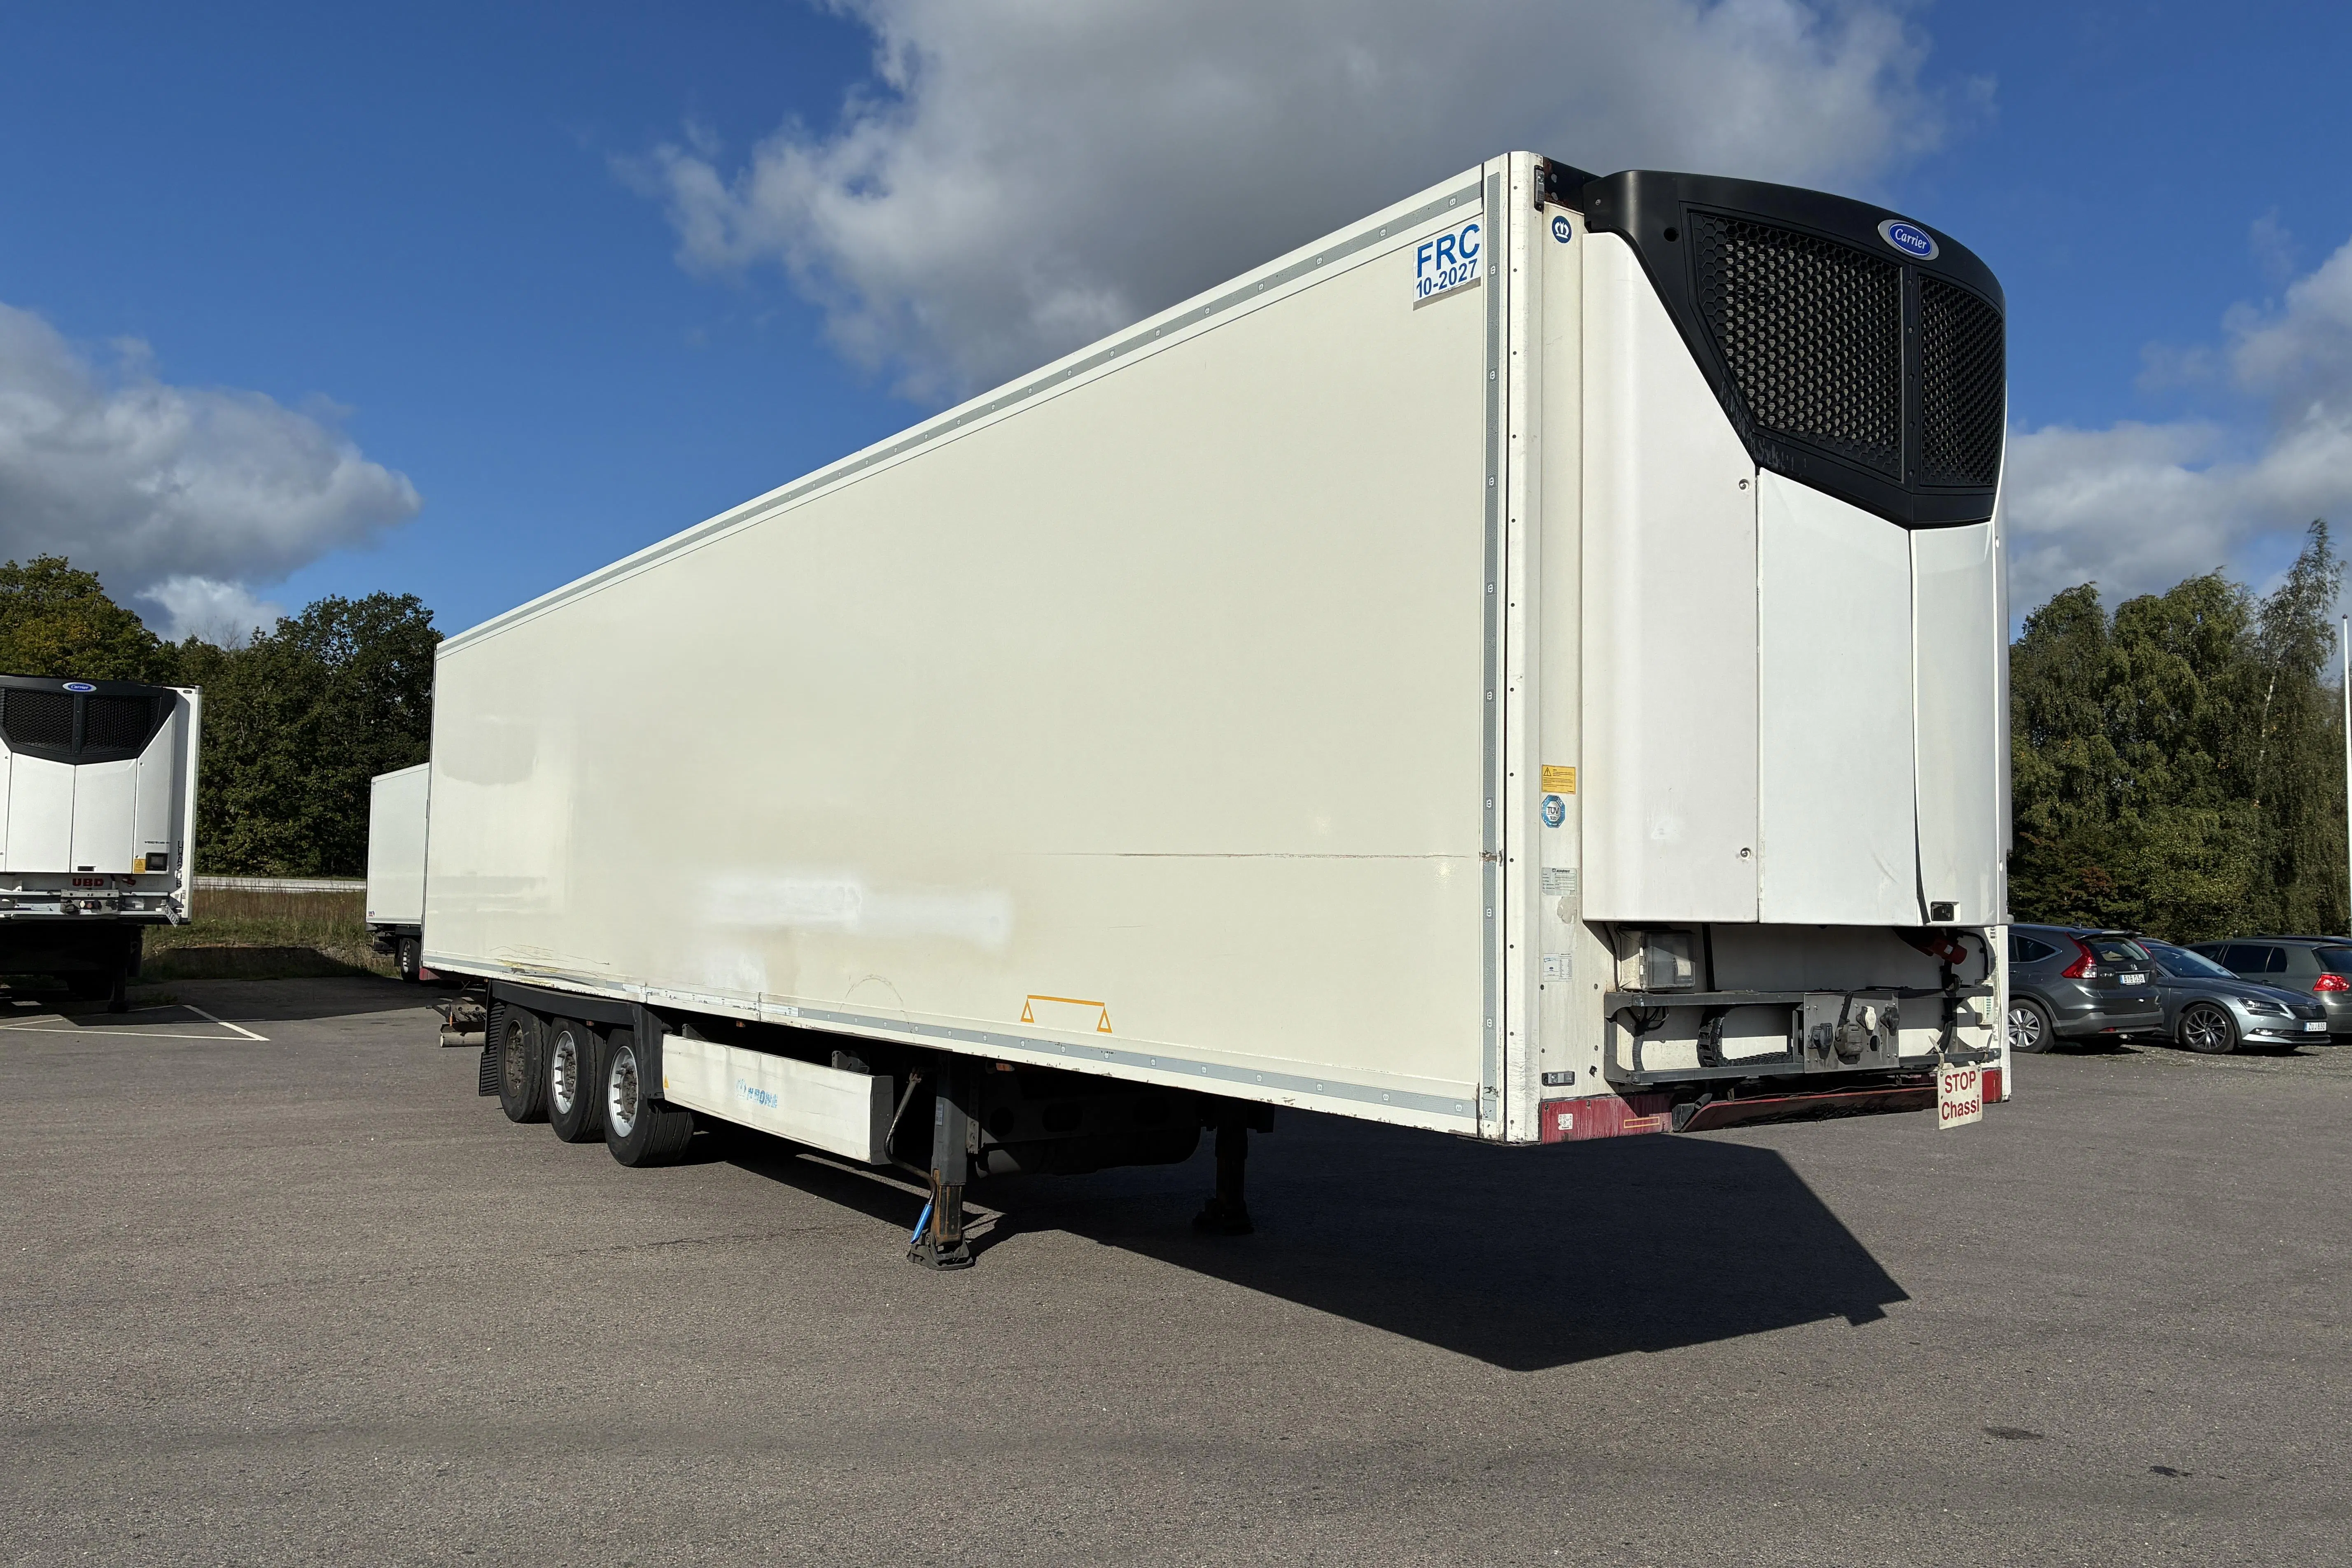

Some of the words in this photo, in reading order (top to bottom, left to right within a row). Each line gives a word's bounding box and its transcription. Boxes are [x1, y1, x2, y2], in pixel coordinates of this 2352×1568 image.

[1417, 224, 1480, 278] FRC
[1895, 229, 1927, 249] Carrier
[1416, 258, 1478, 298] 10-2027
[1945, 1071, 1976, 1094] STOP
[1942, 1094, 1979, 1120] Chassi
